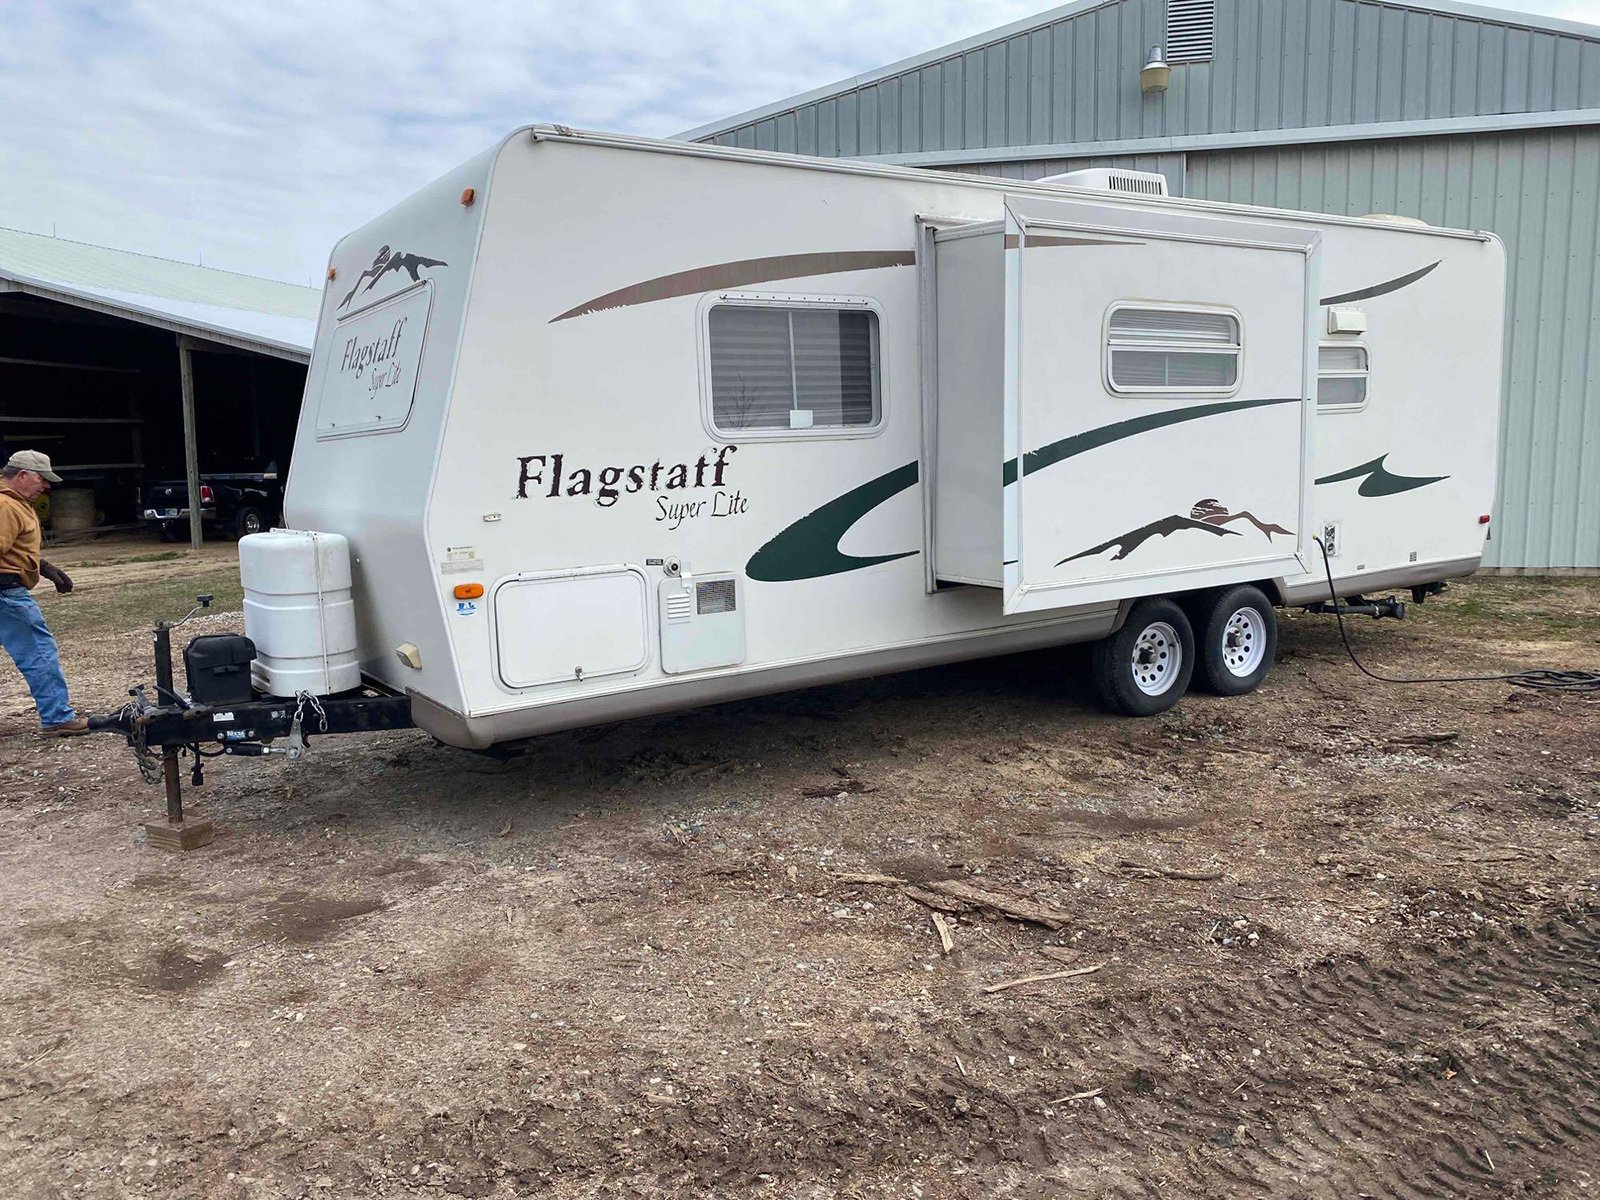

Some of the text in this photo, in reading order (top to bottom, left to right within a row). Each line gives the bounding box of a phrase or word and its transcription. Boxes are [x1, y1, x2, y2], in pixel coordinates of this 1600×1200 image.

[341, 317, 408, 379] Flagstaff
[369, 368, 387, 400] Super
[512, 445, 738, 507] Flagstaff
[655, 491, 749, 530] Super Lite
